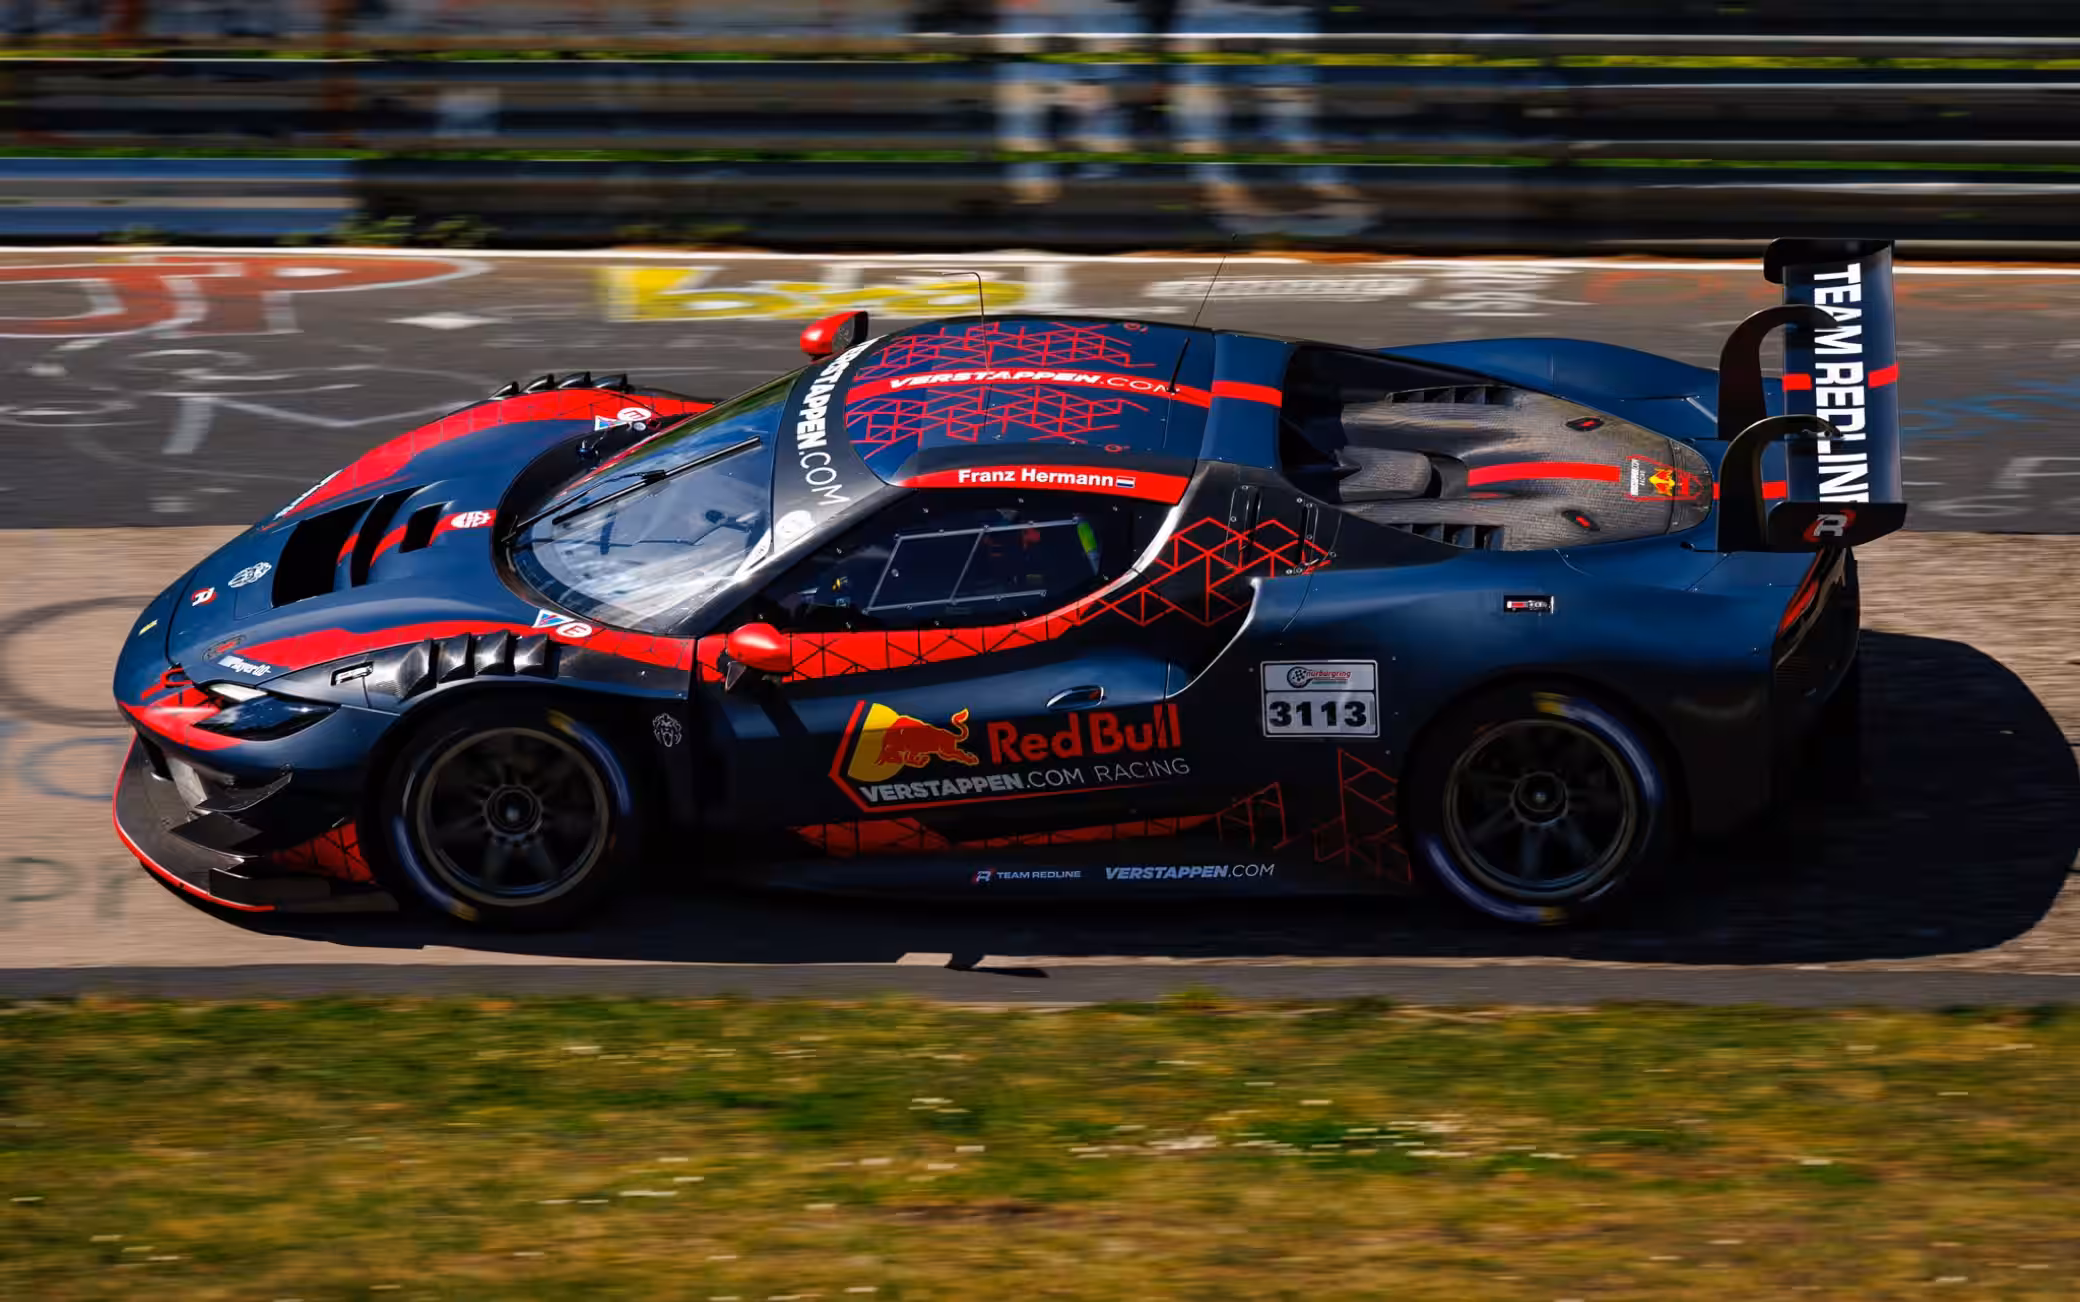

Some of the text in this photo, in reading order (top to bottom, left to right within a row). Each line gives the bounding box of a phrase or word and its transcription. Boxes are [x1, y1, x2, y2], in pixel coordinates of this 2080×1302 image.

[1813, 262, 1870, 503] TEAM REDLIN
[957, 468, 1114, 487] Franz Hermann
[1268, 700, 1367, 728] 3113
[987, 703, 1182, 764] Red Bull
[859, 757, 1191, 803] VERSTAPPEN.COM RACING
[996, 870, 1031, 880] TEAM
[1031, 870, 1081, 879] REDLINE
[1105, 863, 1275, 880] VERSTAPPEN.COM
